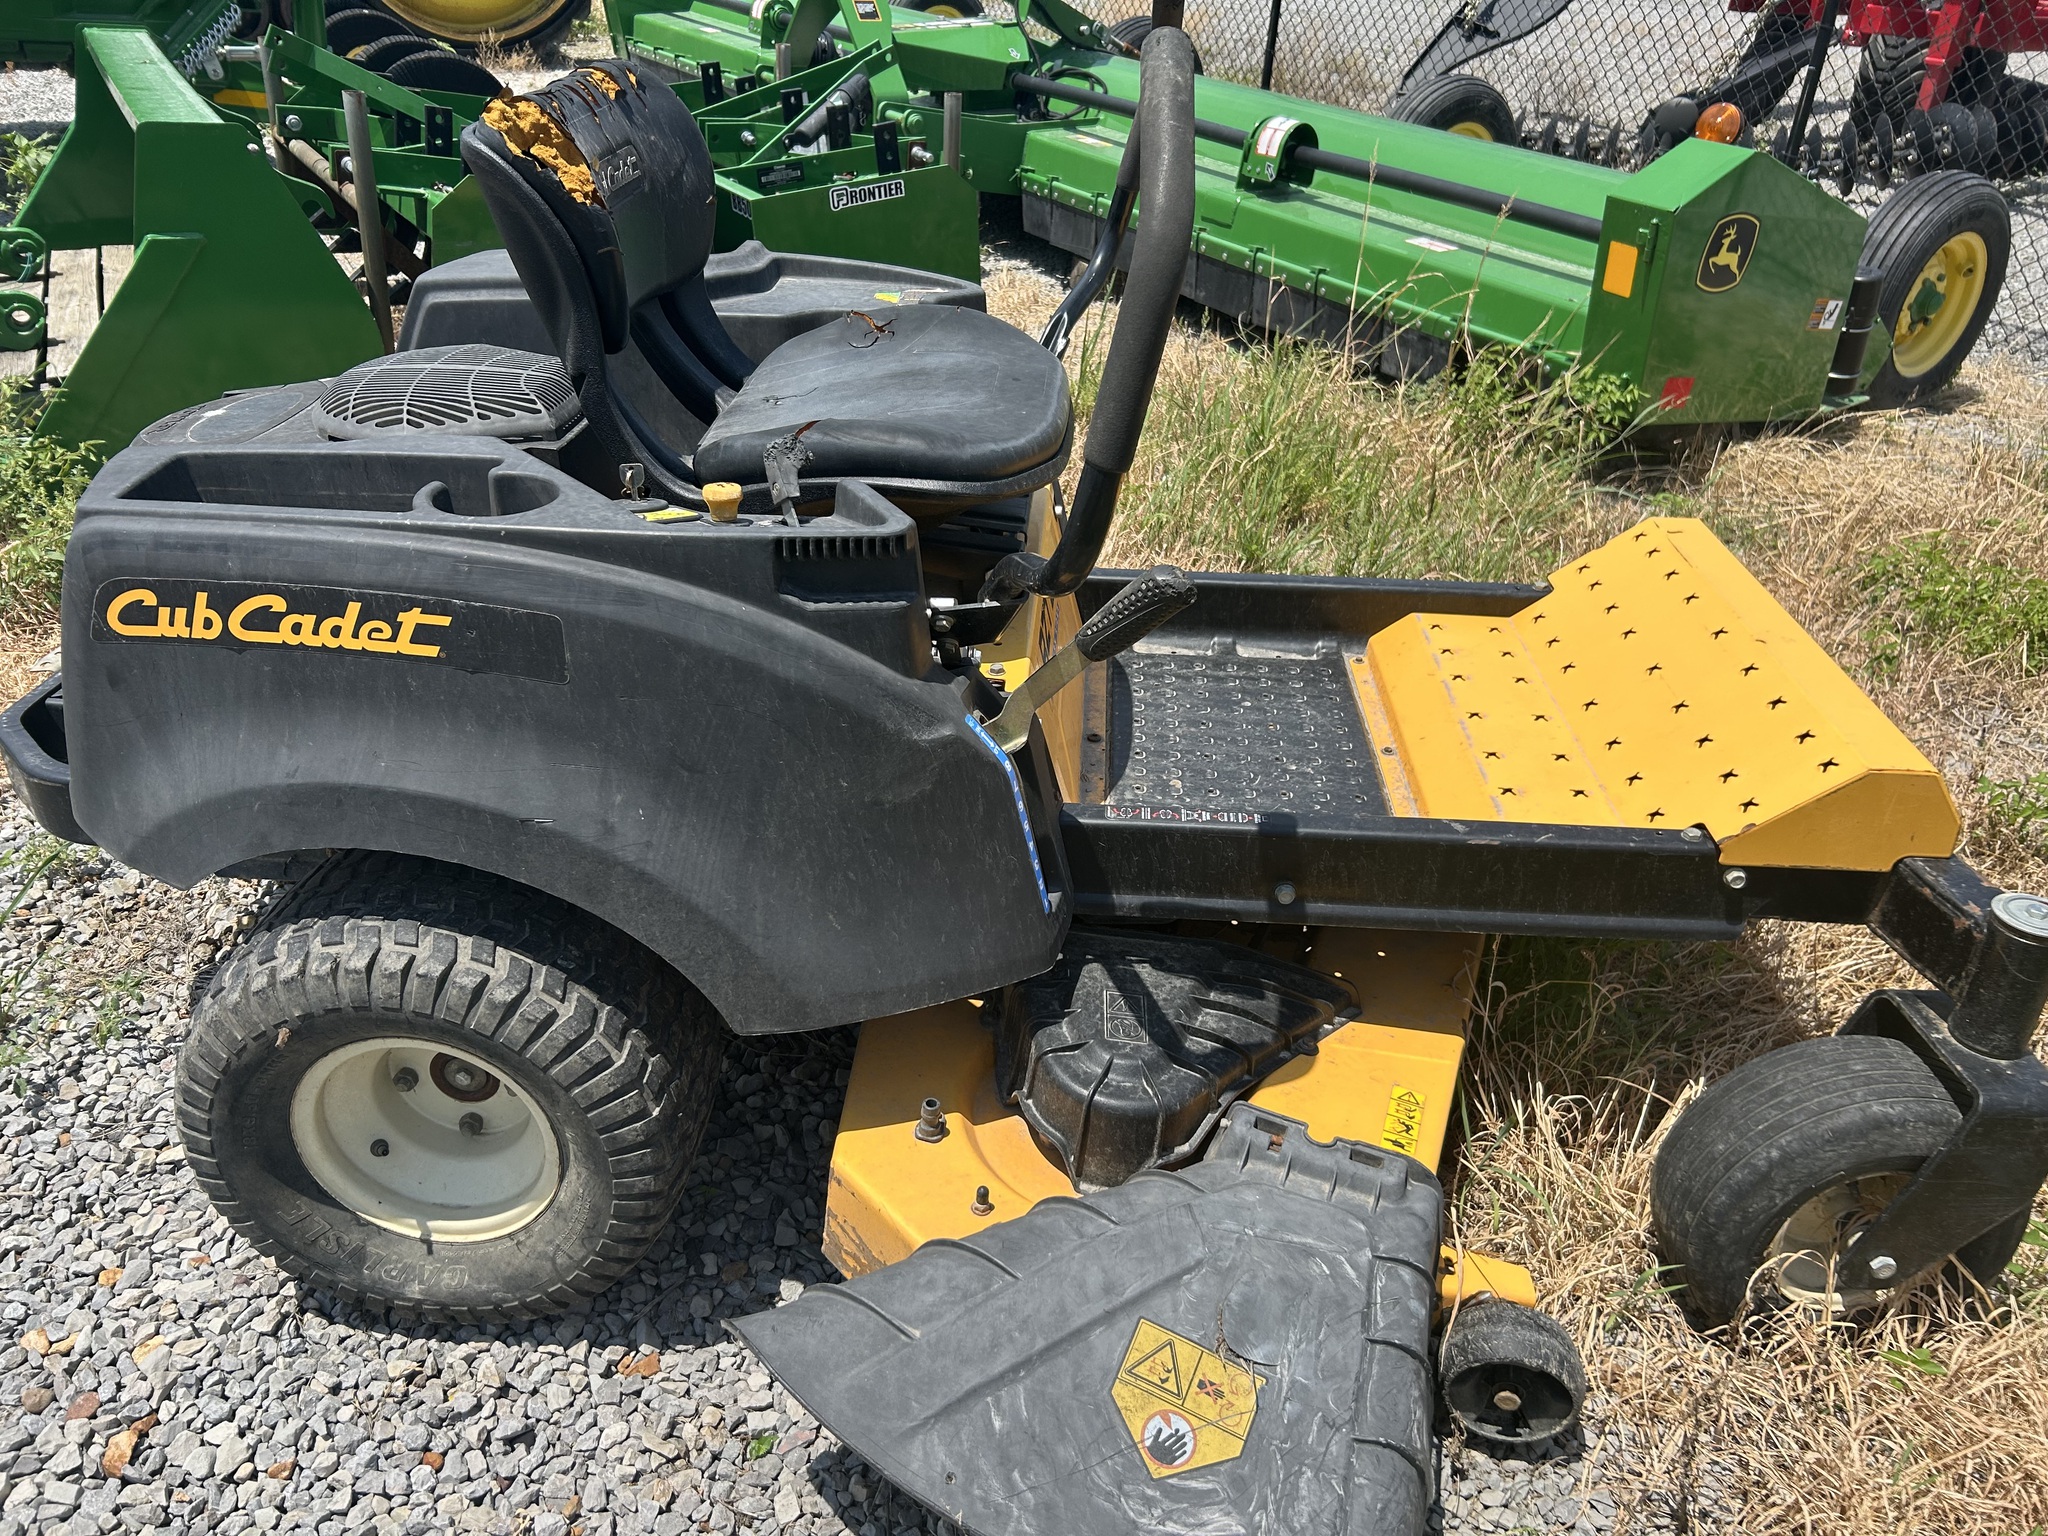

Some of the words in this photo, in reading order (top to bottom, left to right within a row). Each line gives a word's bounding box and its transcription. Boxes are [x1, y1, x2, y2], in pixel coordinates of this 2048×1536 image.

[830, 180, 904, 211] FRONTIER
[106, 588, 222, 641] Cub
[228, 594, 453, 658] Cadet
[276, 1201, 468, 1290] CARLISLE
